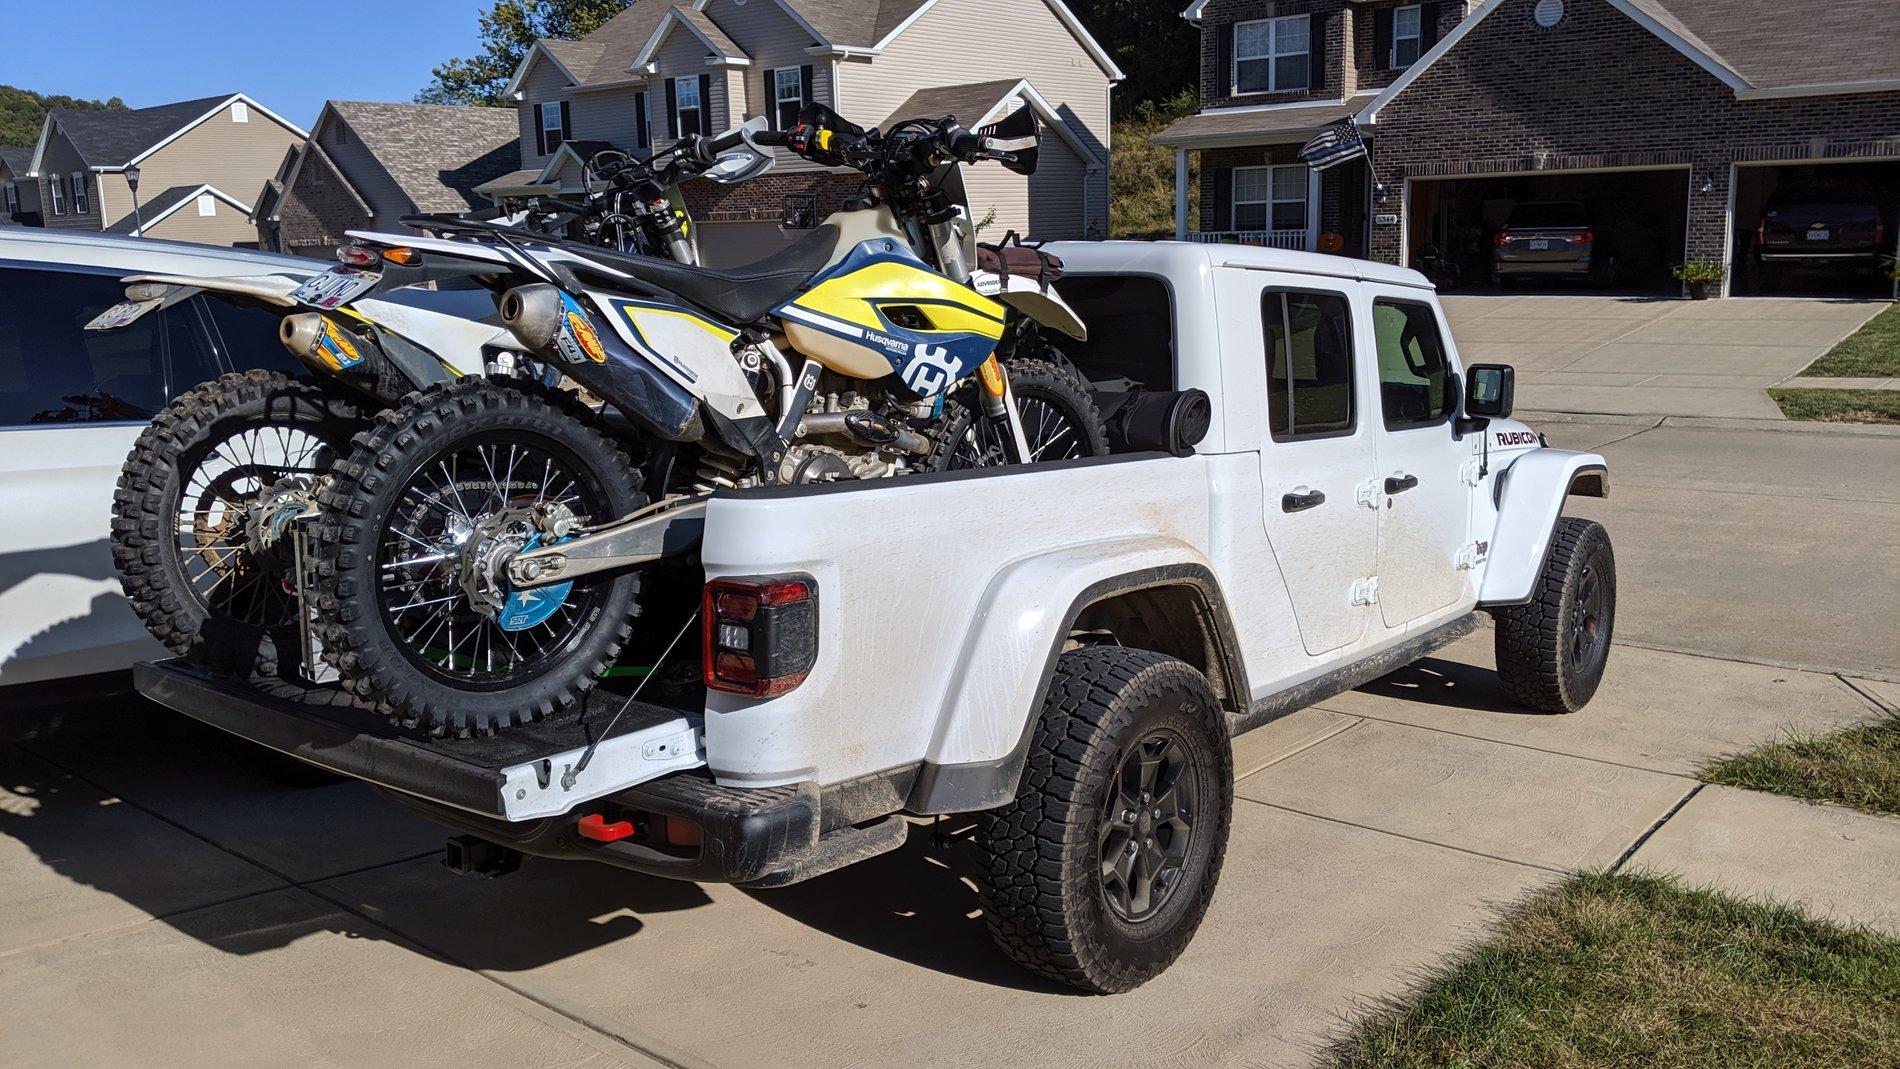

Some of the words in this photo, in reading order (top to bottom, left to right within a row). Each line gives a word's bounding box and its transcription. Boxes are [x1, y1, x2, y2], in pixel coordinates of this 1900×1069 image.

[976, 279, 1001, 288] ADVRIDE
[865, 330, 909, 351] Husqvarna
[1495, 431, 1539, 446] RUBICON
